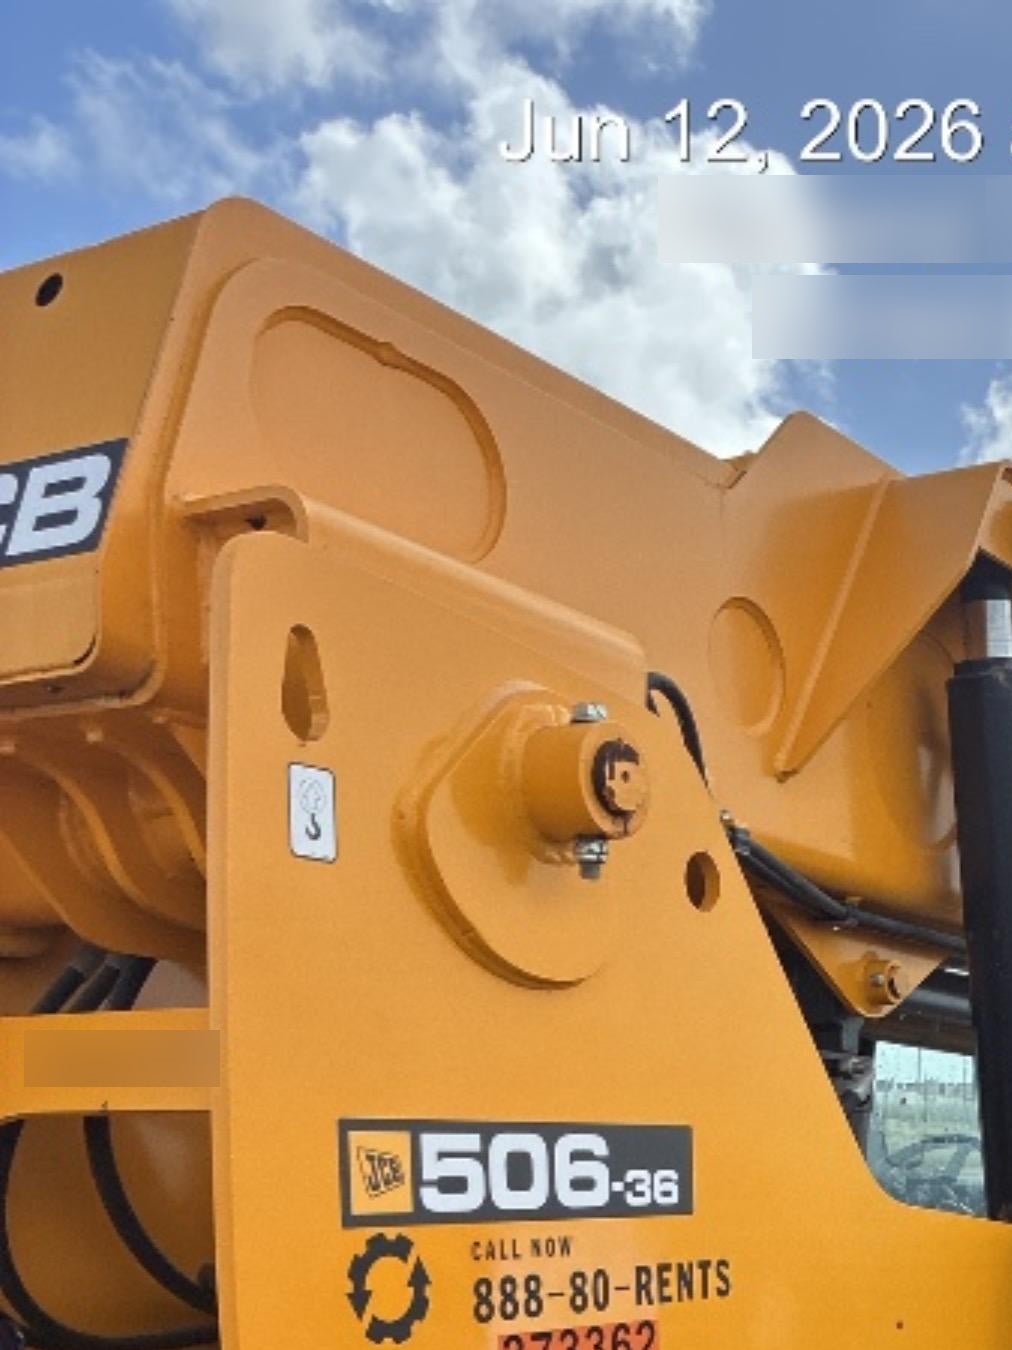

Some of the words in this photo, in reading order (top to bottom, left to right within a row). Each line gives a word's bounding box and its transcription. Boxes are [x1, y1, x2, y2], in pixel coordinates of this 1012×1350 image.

[0, 452, 111, 556] B
[418, 1132, 681, 1213] 506-36
[471, 1238, 523, 1261] CALL
[530, 1235, 573, 1257] NOW
[472, 1258, 732, 1323] 888-80-RENTS
